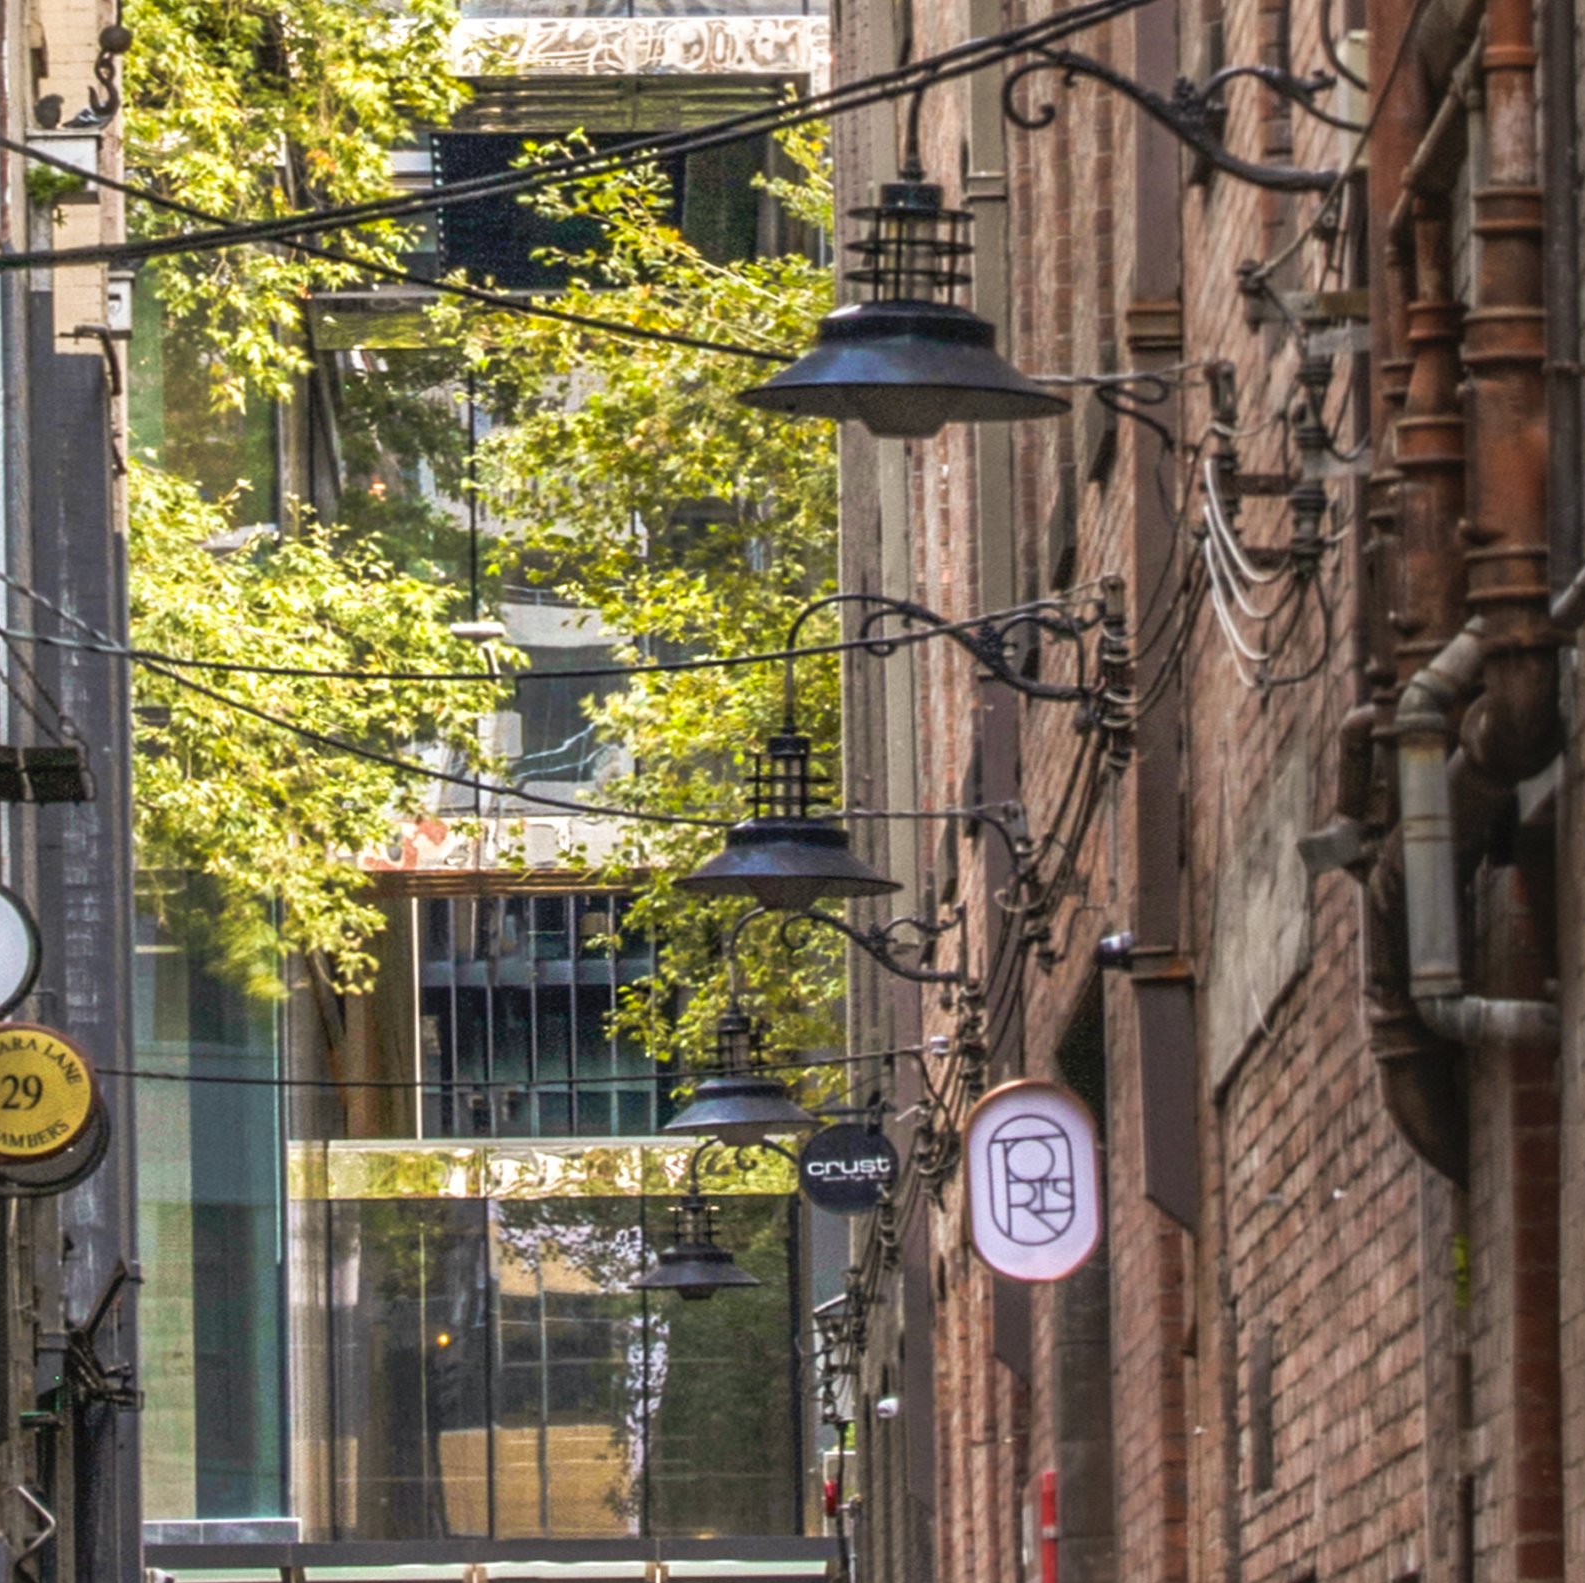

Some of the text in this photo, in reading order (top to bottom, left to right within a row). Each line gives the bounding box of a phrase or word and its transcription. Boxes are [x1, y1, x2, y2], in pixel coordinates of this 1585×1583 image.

[43, 1042, 83, 1086] LANE
[1, 1074, 44, 1111] 29
[807, 1156, 891, 1177] crust
